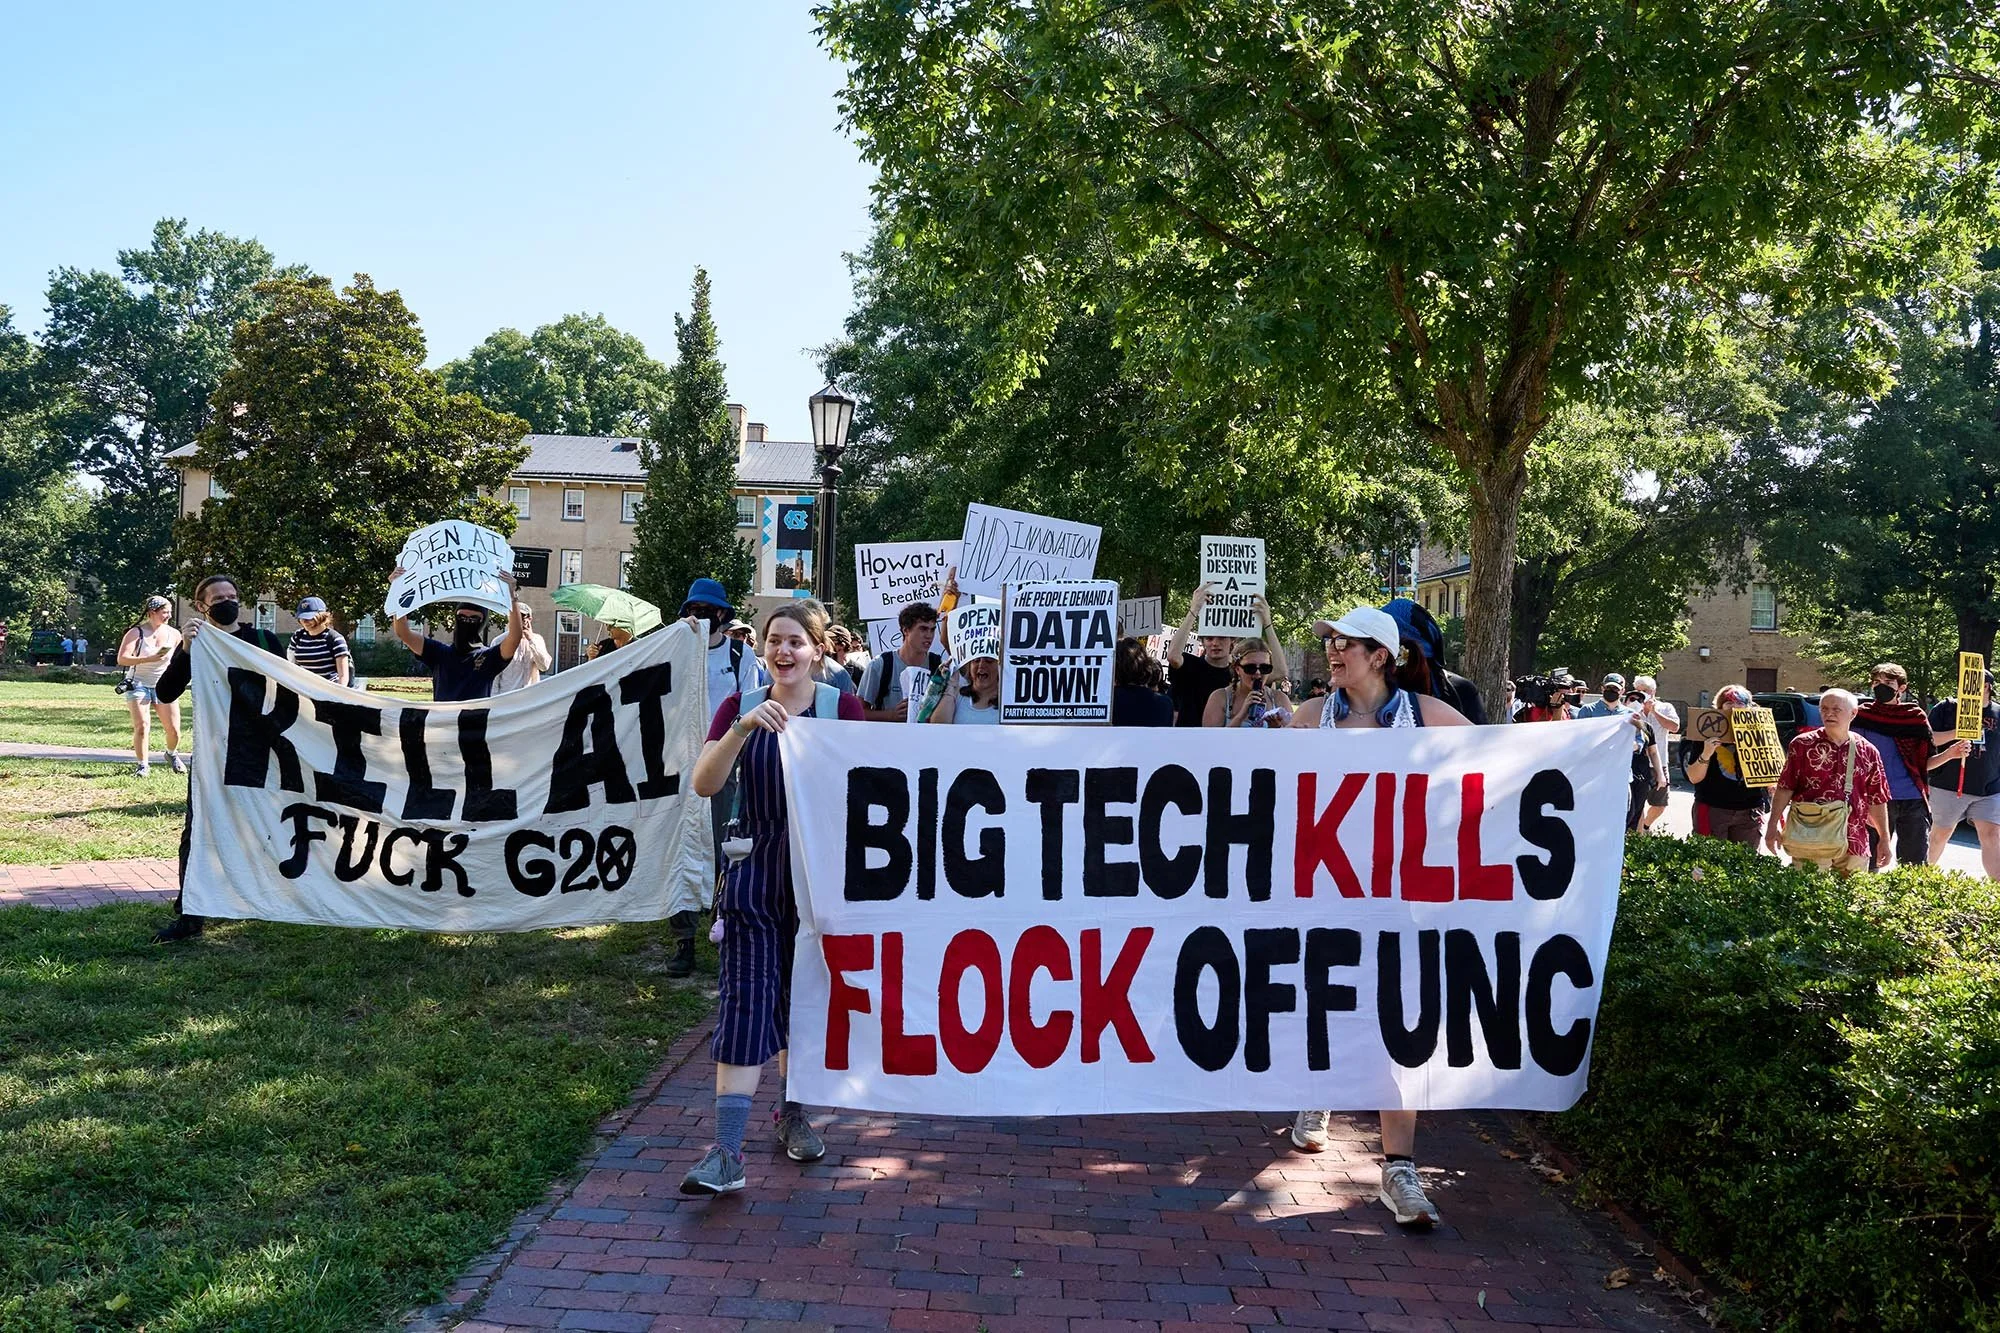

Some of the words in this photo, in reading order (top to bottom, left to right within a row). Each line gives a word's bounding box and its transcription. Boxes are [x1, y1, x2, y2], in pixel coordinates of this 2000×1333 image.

[400, 525, 461, 571] OPEN
[473, 528, 503, 558] AI
[959, 510, 1010, 583] END
[1009, 520, 1098, 561] INNOVATION
[1206, 543, 1257, 559] STUDENTS
[424, 549, 488, 570] TRADED
[860, 548, 949, 577] Howard,
[1206, 559, 1257, 575] DESERVE
[418, 566, 505, 601] FREEPORT
[870, 577, 879, 590] I
[887, 570, 939, 589] brought
[1224, 576, 1240, 592] A
[881, 585, 941, 607] Breakfast
[1033, 591, 1069, 607] PEOPLE
[1069, 590, 1107, 607] DEMAND
[1106, 590, 1114, 606] A
[1206, 594, 1257, 607] BRIGHT
[958, 607, 1000, 630] OPEN
[1119, 599, 1161, 630] HIT
[1204, 608, 1255, 629] FUTURE
[954, 633, 961, 645] IS
[1009, 610, 1114, 650] DATA
[956, 643, 966, 665] IN
[1014, 667, 1101, 704] DOWN!
[1005, 708, 1024, 717] PARTY
[1023, 708, 1036, 717] FOR
[1035, 708, 1066, 717] SOCIALISM
[1065, 708, 1073, 717] &
[1073, 708, 1106, 717] LIBERATION
[1733, 710, 1774, 725] WORKERS
[224, 666, 518, 822] KILL
[541, 661, 680, 815] AI
[1735, 730, 1780, 748] POWER
[1739, 749, 1751, 761] TO
[1752, 748, 1784, 761] DEFEAT
[844, 765, 1006, 902] BIG
[1025, 763, 1276, 902] TECH
[1294, 767, 1575, 903] KILLS
[278, 802, 477, 898] FUCK
[822, 924, 1156, 1076] FLOCK
[1173, 925, 1361, 1073] OFF
[1377, 928, 1595, 1076] UNC
